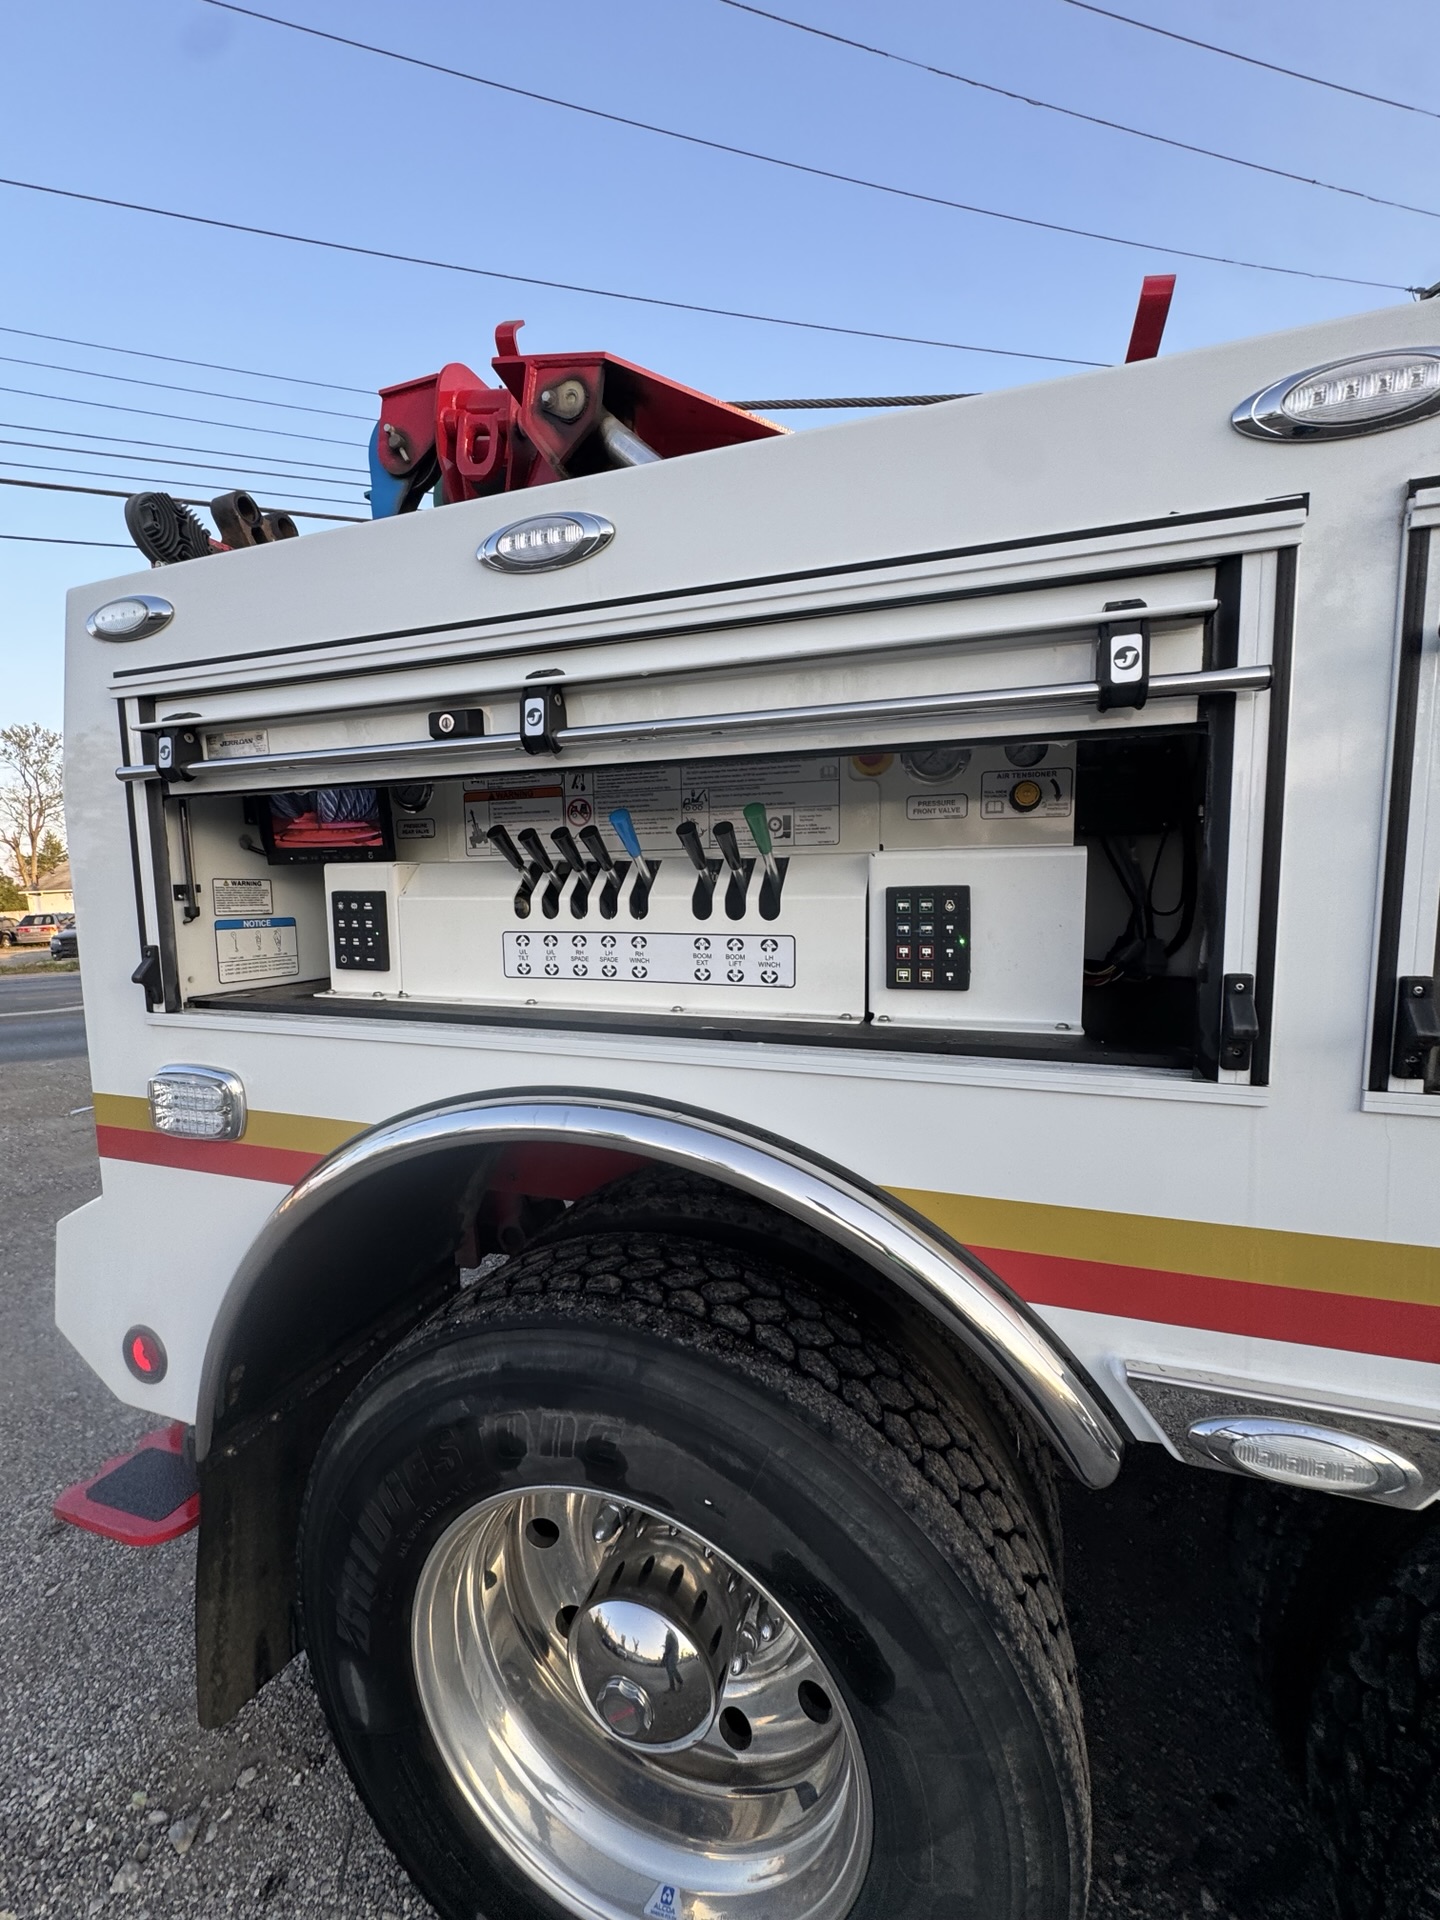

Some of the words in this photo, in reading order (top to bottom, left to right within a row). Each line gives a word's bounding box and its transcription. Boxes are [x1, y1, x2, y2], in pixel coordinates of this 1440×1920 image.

[996, 772, 1010, 780] AIR
[1012, 770, 1057, 779] TENSIONER
[917, 799, 956, 807] PRESSURE
[243, 919, 271, 928] NOTICE
[653, 1902, 676, 1915] ALCOA
